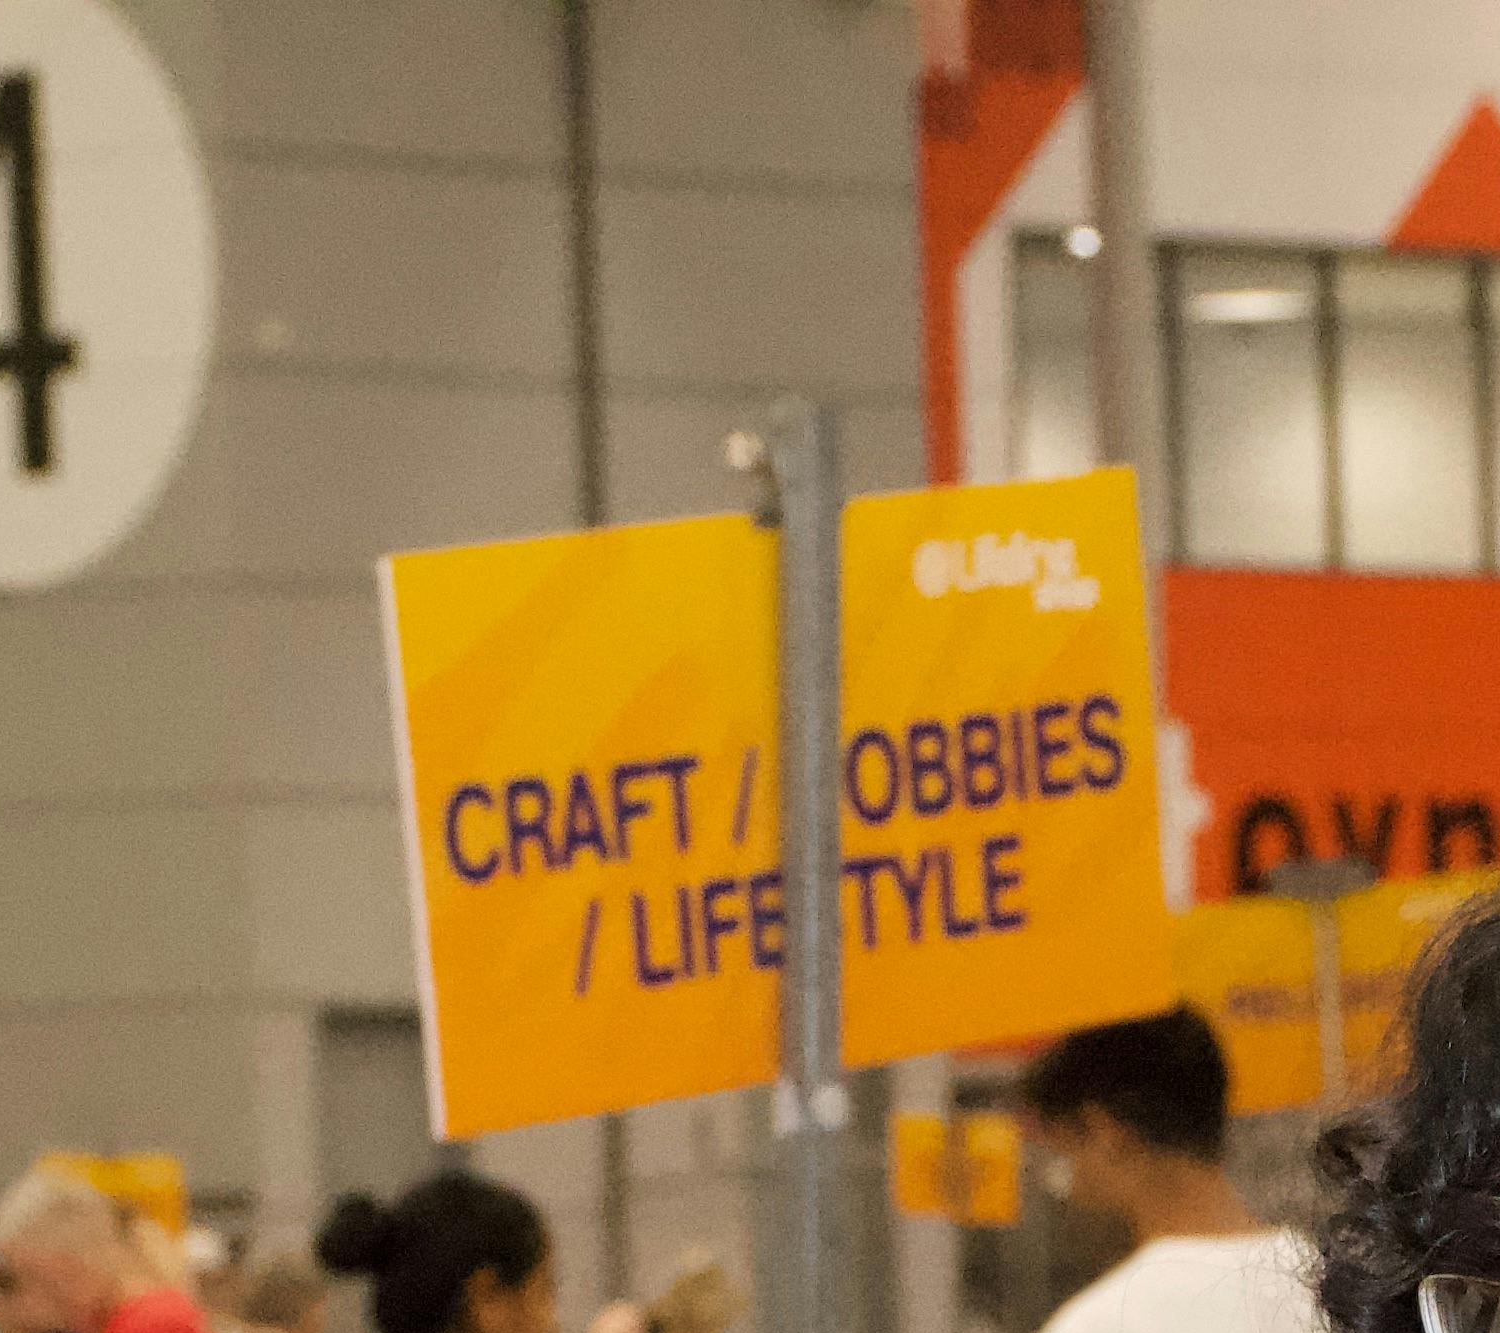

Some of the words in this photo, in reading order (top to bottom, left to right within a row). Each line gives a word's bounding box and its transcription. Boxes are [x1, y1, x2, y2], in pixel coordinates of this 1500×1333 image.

[445, 755, 700, 884] CRAFT
[732, 745, 758, 848] /
[844, 692, 1128, 826] OBBIES
[574, 895, 601, 997] /
[631, 833, 1028, 990] LIFETYLE
